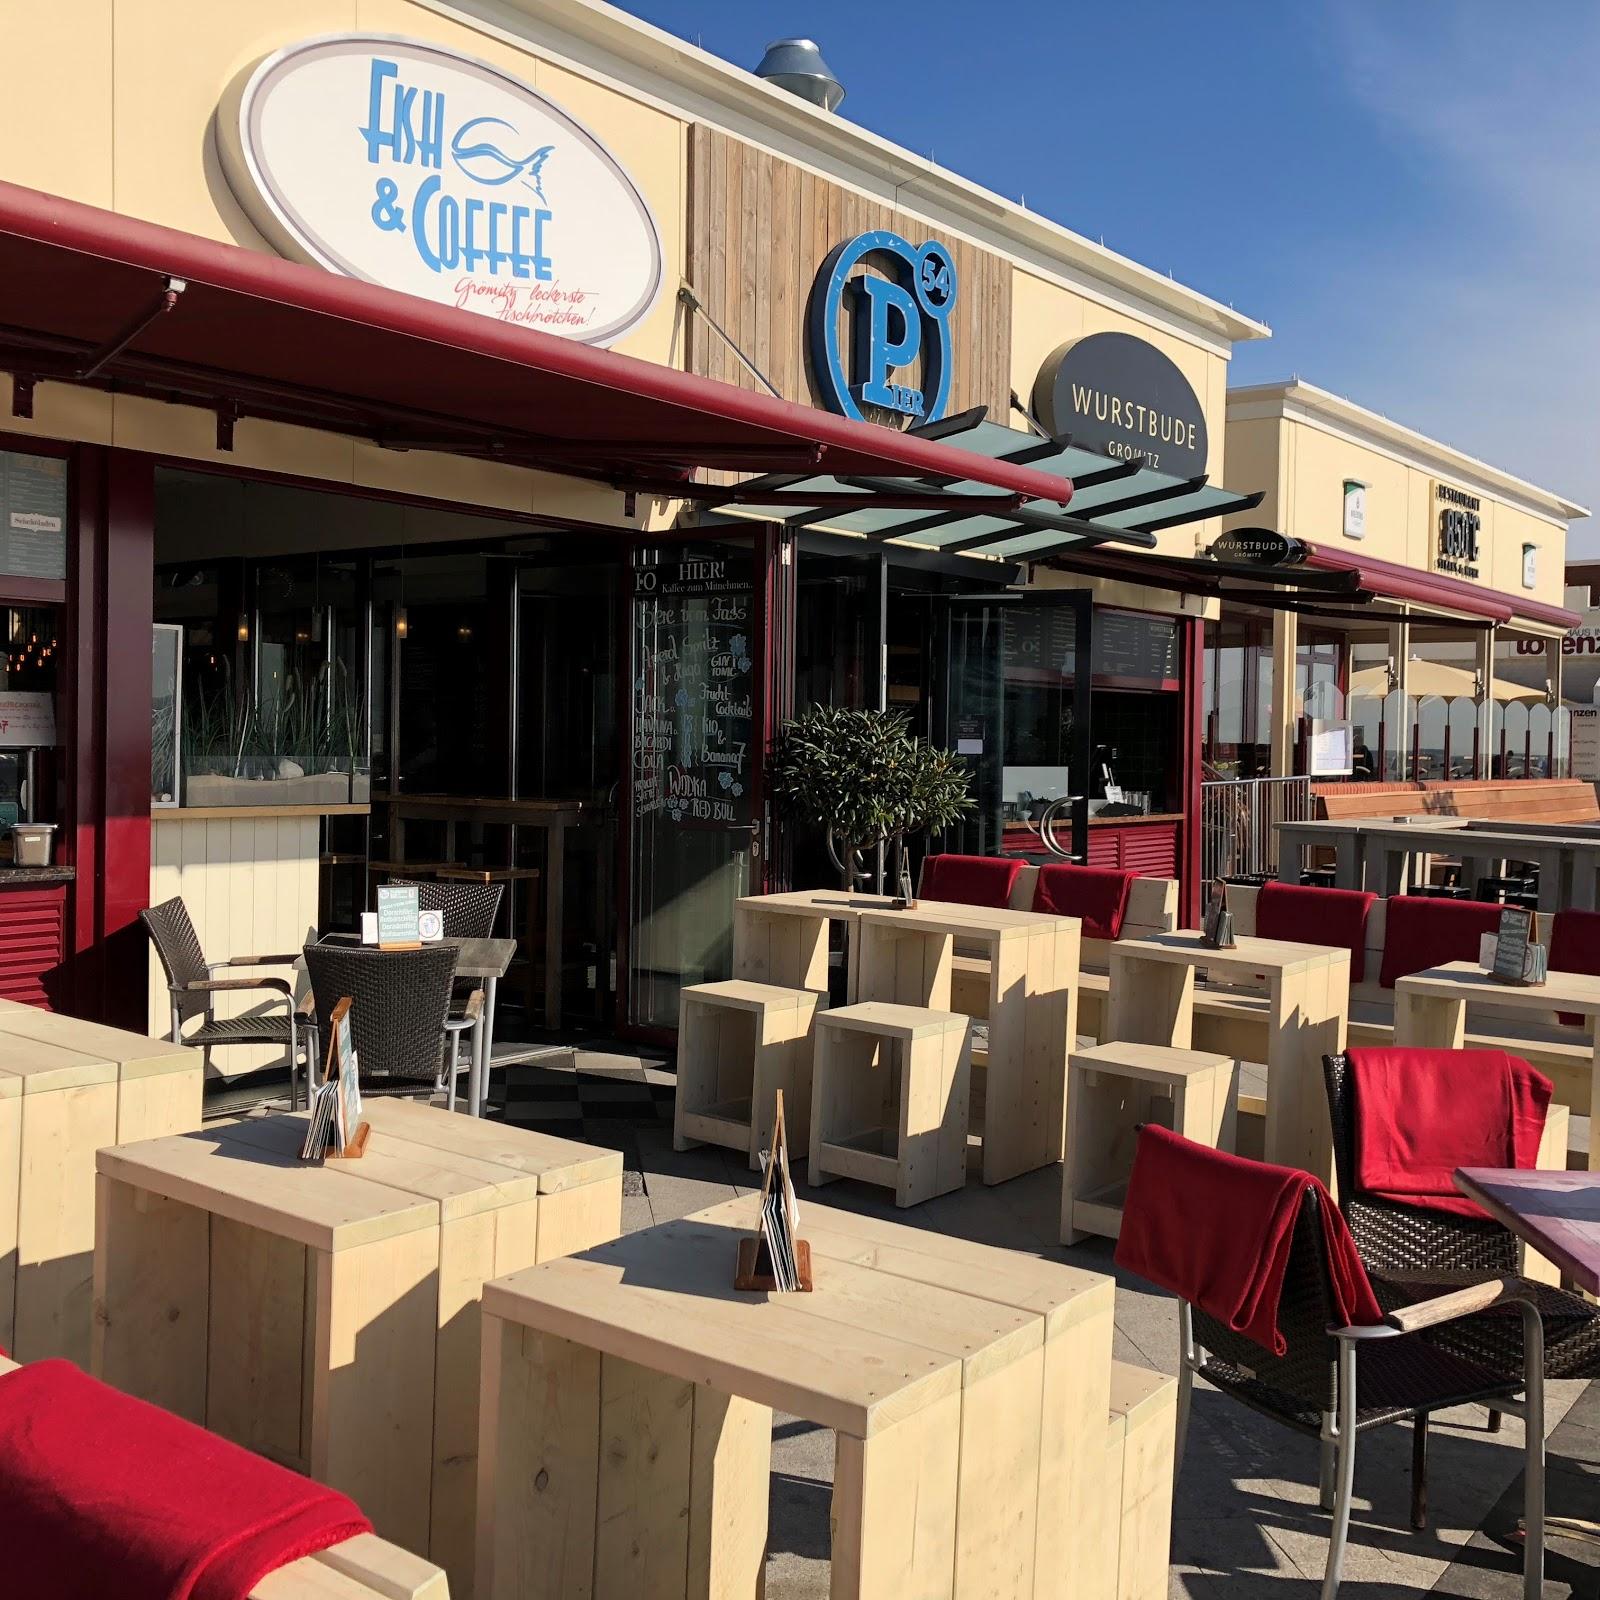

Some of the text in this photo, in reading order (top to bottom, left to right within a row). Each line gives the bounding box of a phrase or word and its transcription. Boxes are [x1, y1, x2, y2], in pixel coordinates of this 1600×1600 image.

[358, 58, 445, 169] FISH
[371, 174, 552, 281] & COFFEE
[922, 259, 951, 297] 54
[863, 275, 925, 417] PIER
[1072, 383, 1196, 450] WURSTBUDE
[1218, 541, 1284, 550] WURSTBUDE
[679, 561, 725, 581] HIER!
[662, 583, 685, 593] Kaffee
[1574, 709, 1597, 717] nzen
[667, 765, 707, 797] WODKA
[691, 799, 736, 821] RED BULL
